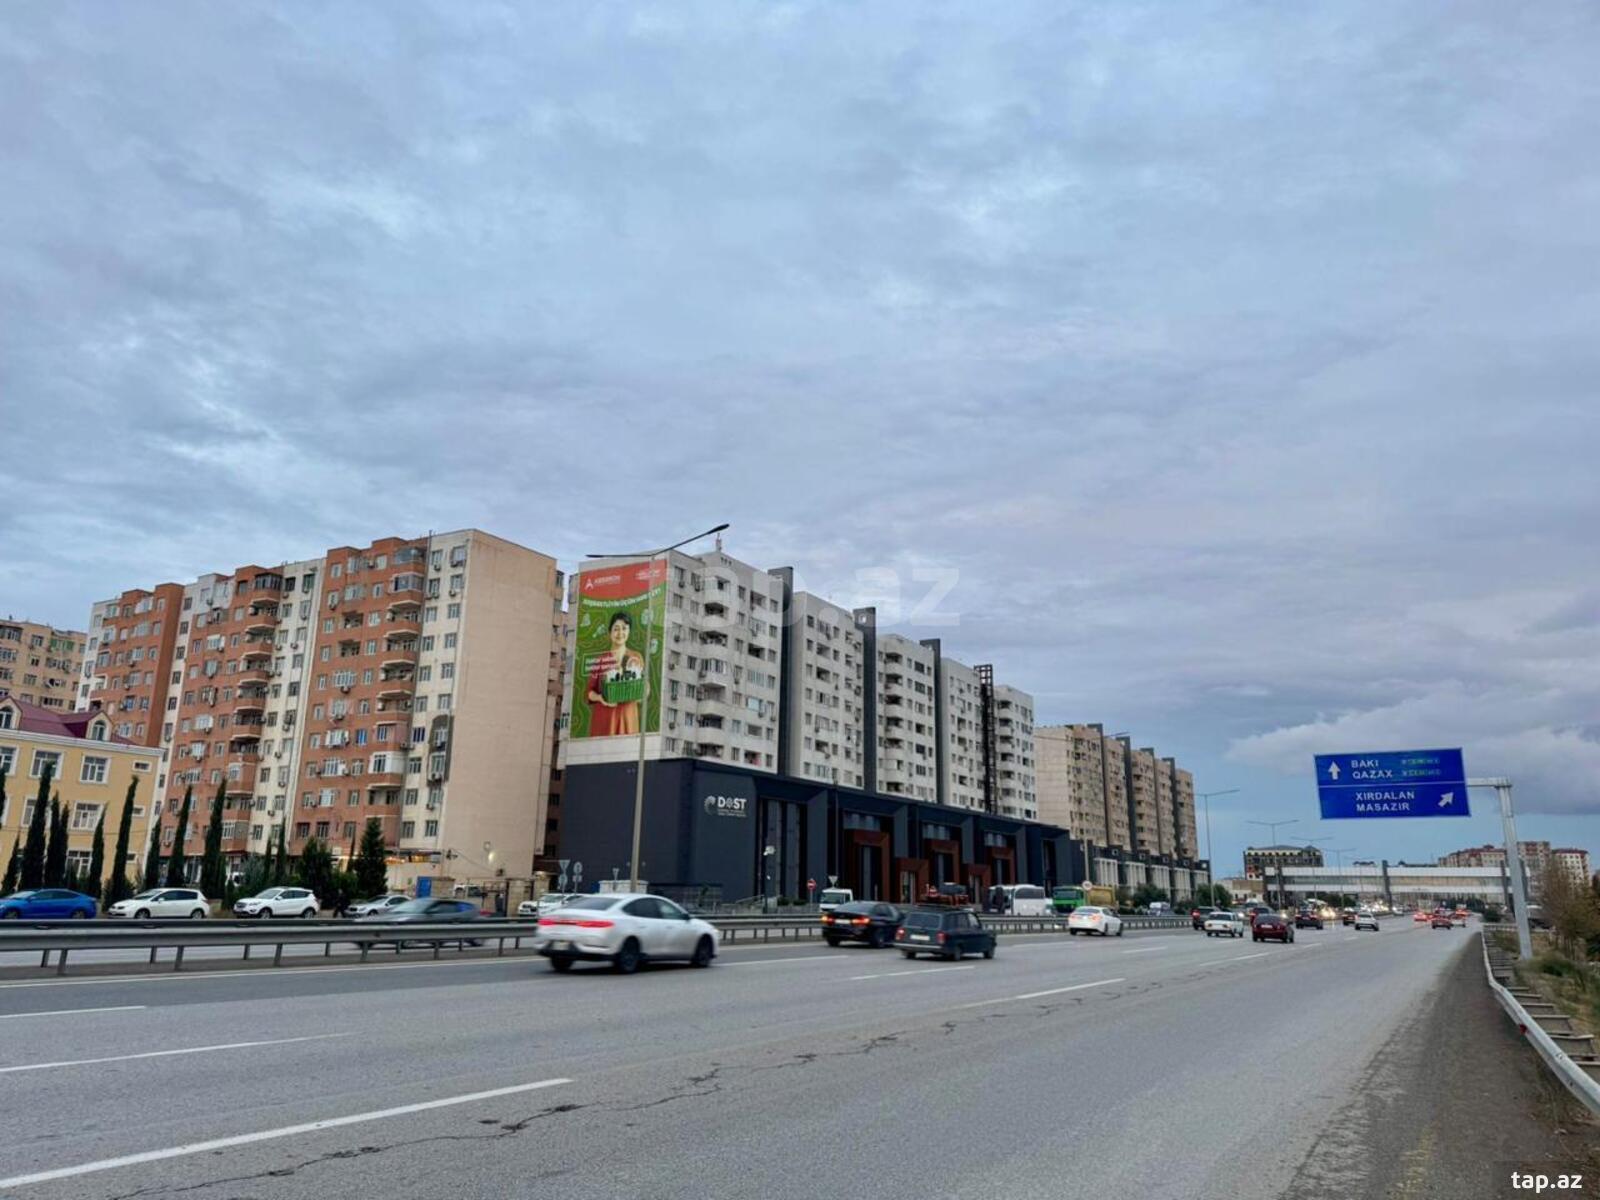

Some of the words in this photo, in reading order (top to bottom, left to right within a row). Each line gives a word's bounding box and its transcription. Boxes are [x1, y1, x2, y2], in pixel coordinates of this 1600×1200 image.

[1351, 759, 1379, 769] BAKI
[1352, 769, 1393, 780] QAZAX
[1355, 791, 1415, 802] XIRDALAN
[1356, 803, 1410, 813] MASAZIR
